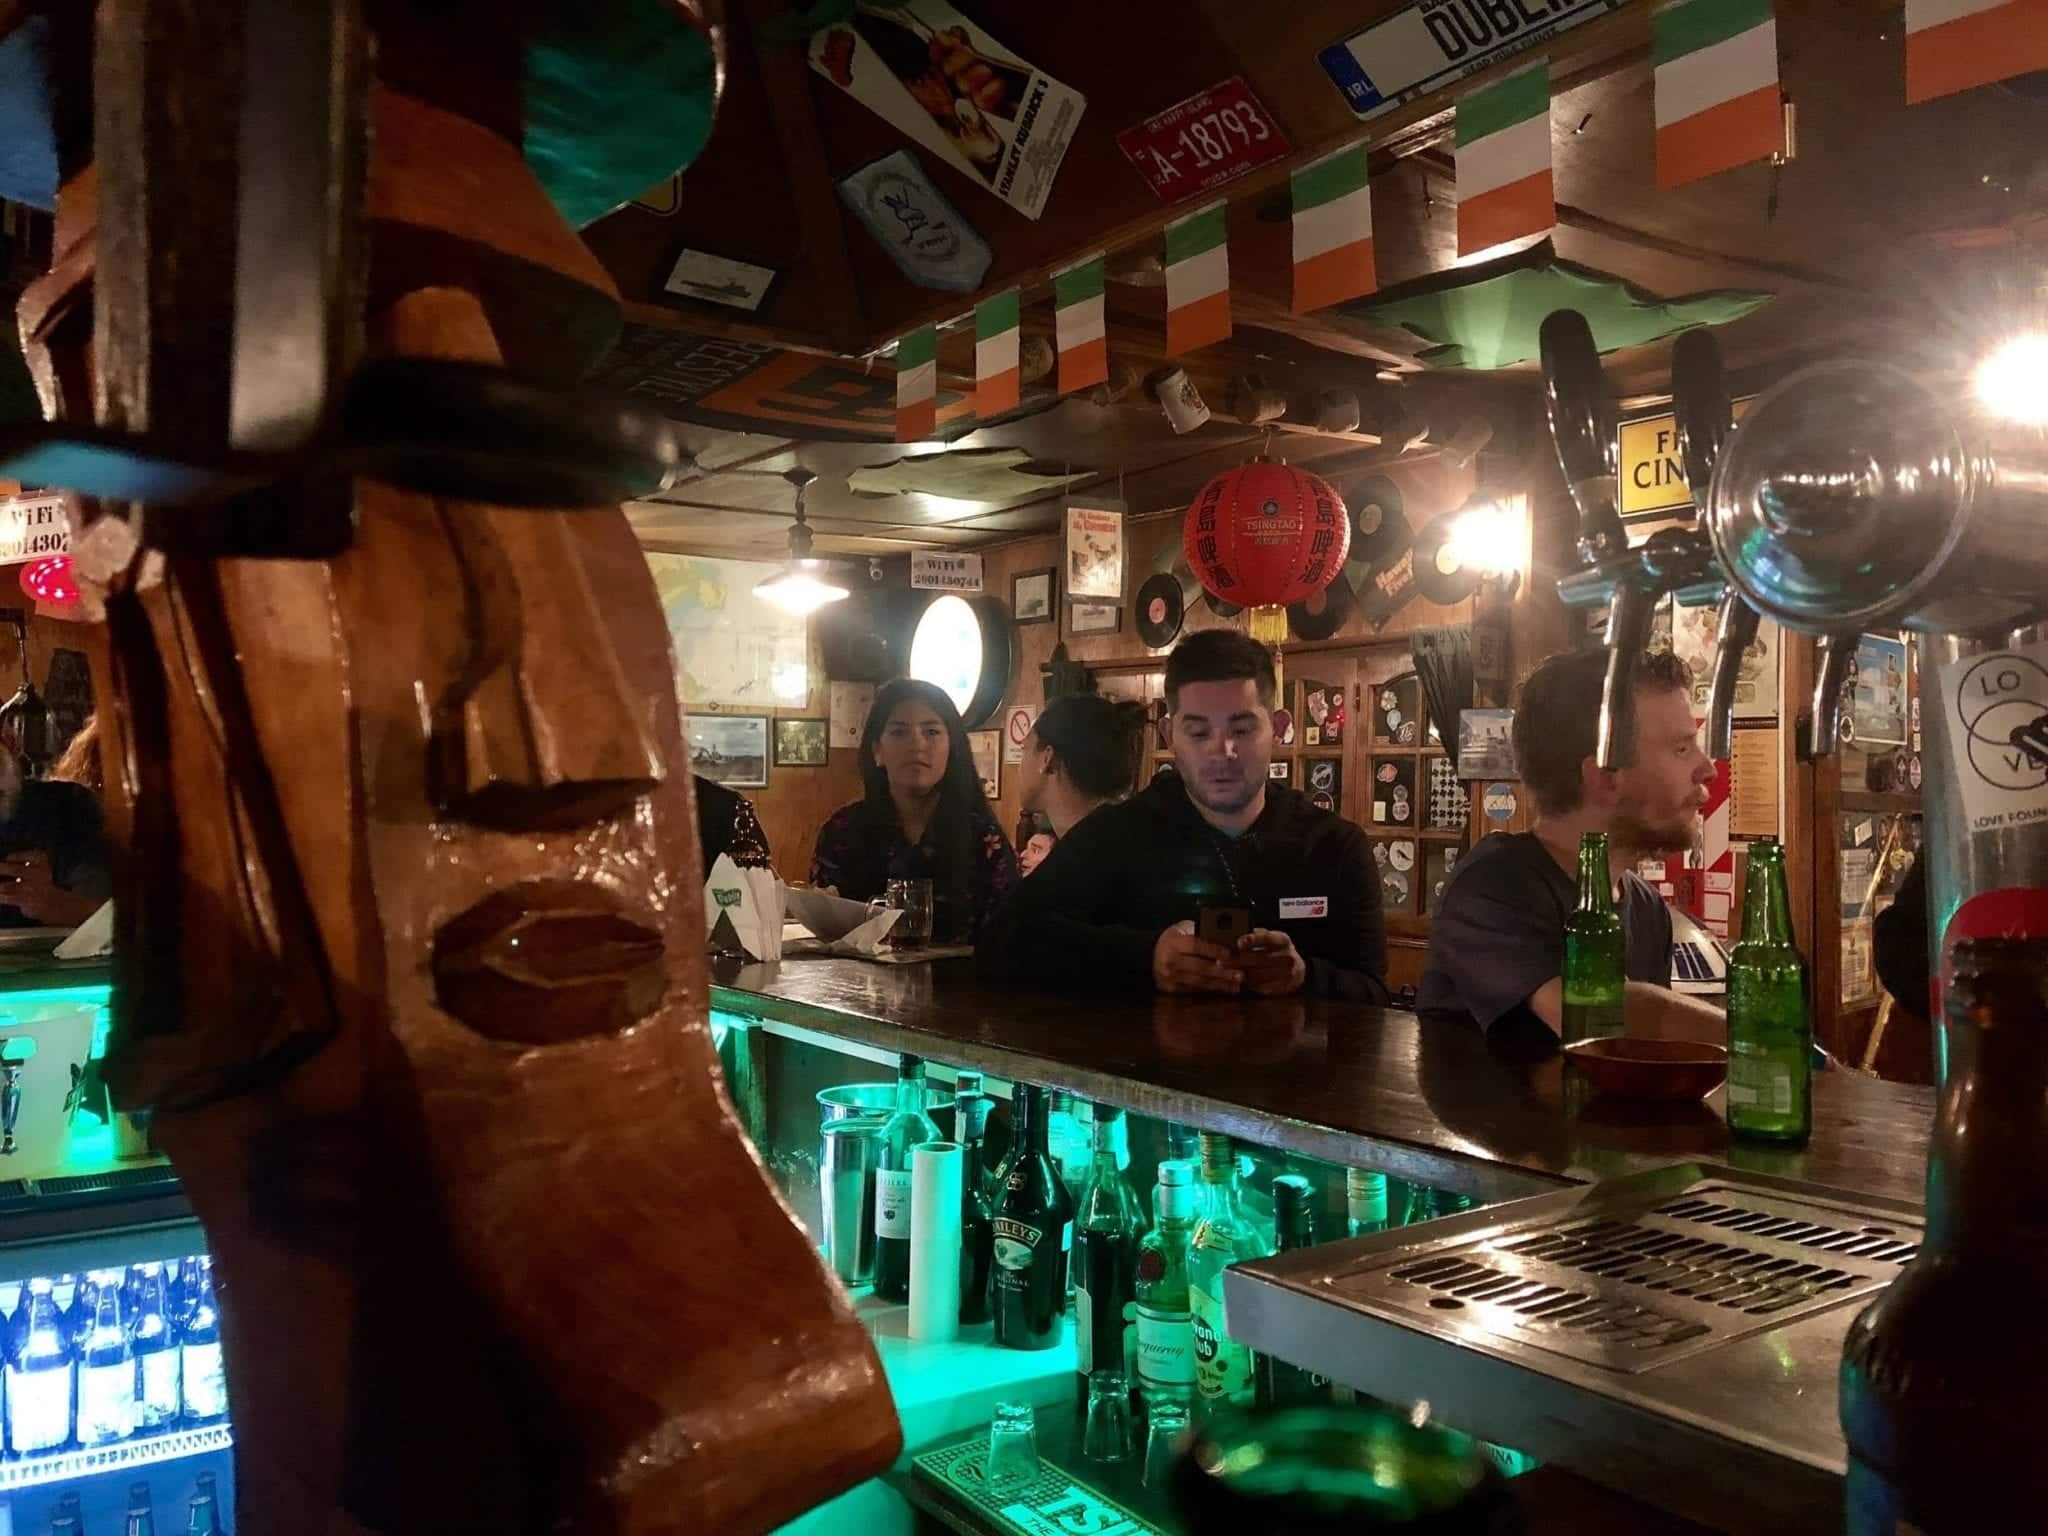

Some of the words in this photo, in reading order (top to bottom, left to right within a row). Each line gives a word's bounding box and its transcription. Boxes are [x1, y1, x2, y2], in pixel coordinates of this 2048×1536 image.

[1422, 0, 1580, 61] DUBL
[1346, 79, 1375, 99] IRL
[1150, 100, 1270, 184] A-18793
[1246, 519, 1297, 531] TSINGTAO
[1981, 670, 2021, 697] LO
[1973, 813, 2004, 828] LOVE
[994, 1219, 1036, 1242] AILEYS
